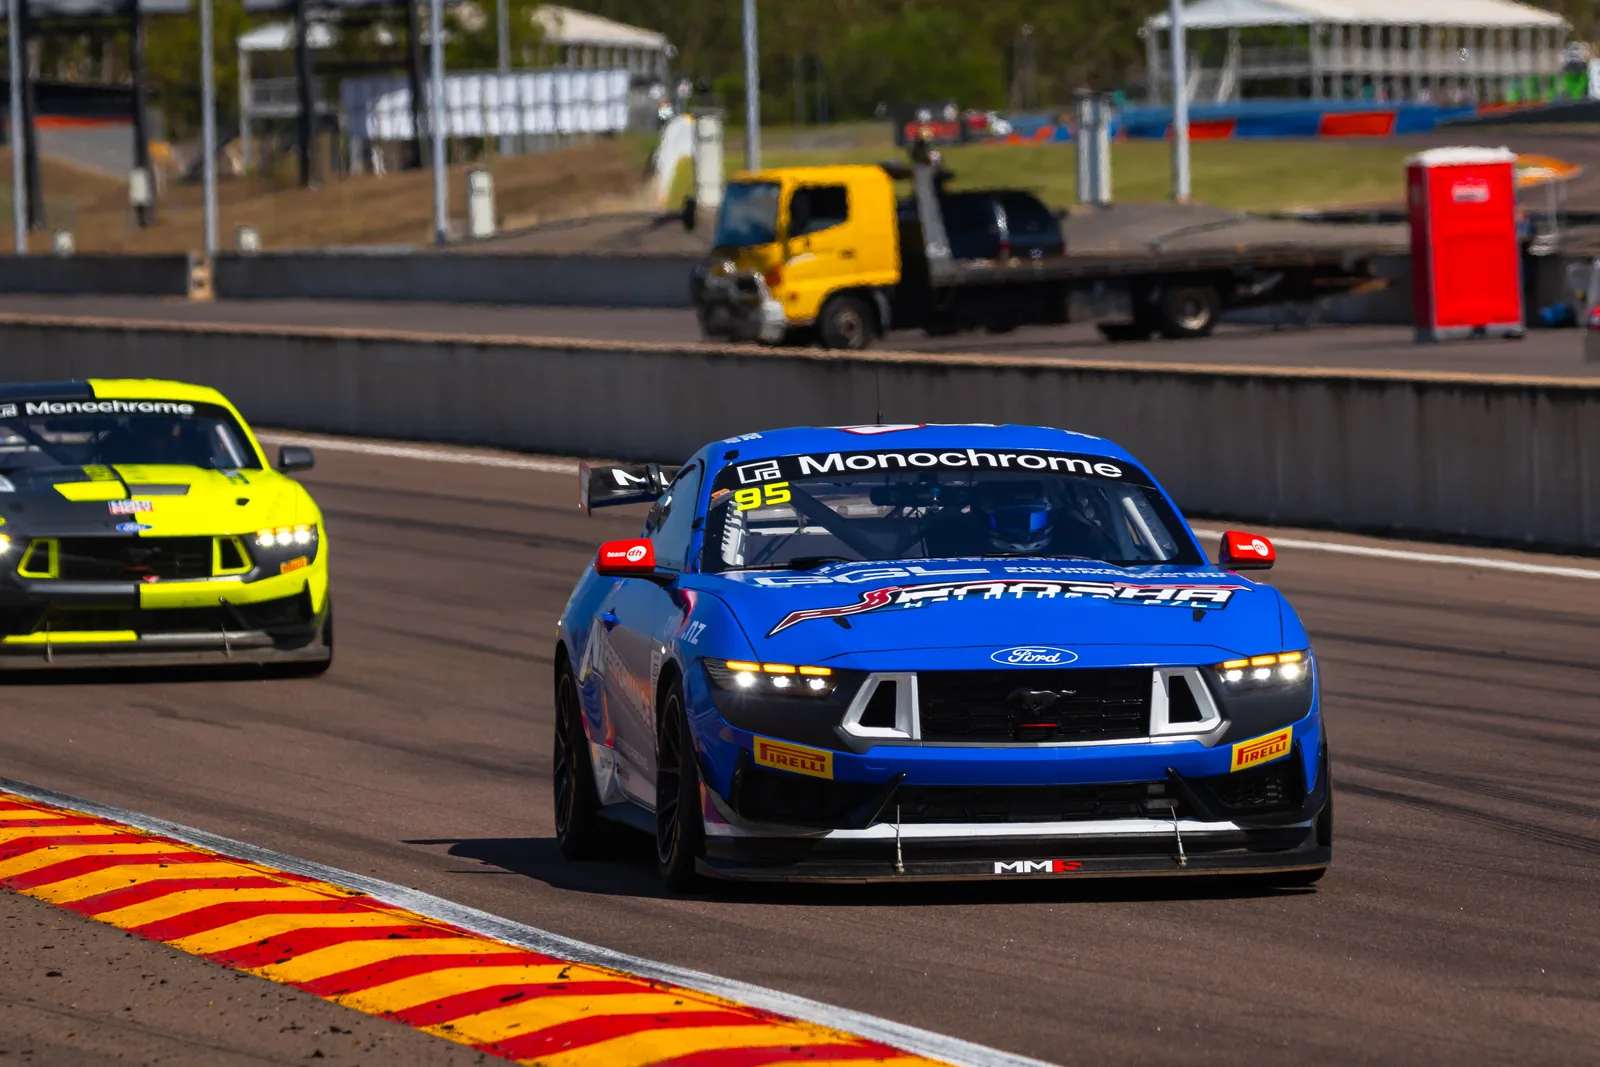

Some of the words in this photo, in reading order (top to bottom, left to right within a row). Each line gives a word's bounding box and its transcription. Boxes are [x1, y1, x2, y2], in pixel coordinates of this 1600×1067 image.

[25, 400, 195, 415] Monochrome
[799, 448, 1123, 479] Monochrome
[734, 481, 792, 511] 95
[606, 551, 626, 559] team
[628, 548, 643, 557] dh
[1006, 647, 1062, 664] Ford
[759, 742, 827, 773] PIRELLI
[1236, 733, 1288, 766] PIRELLI
